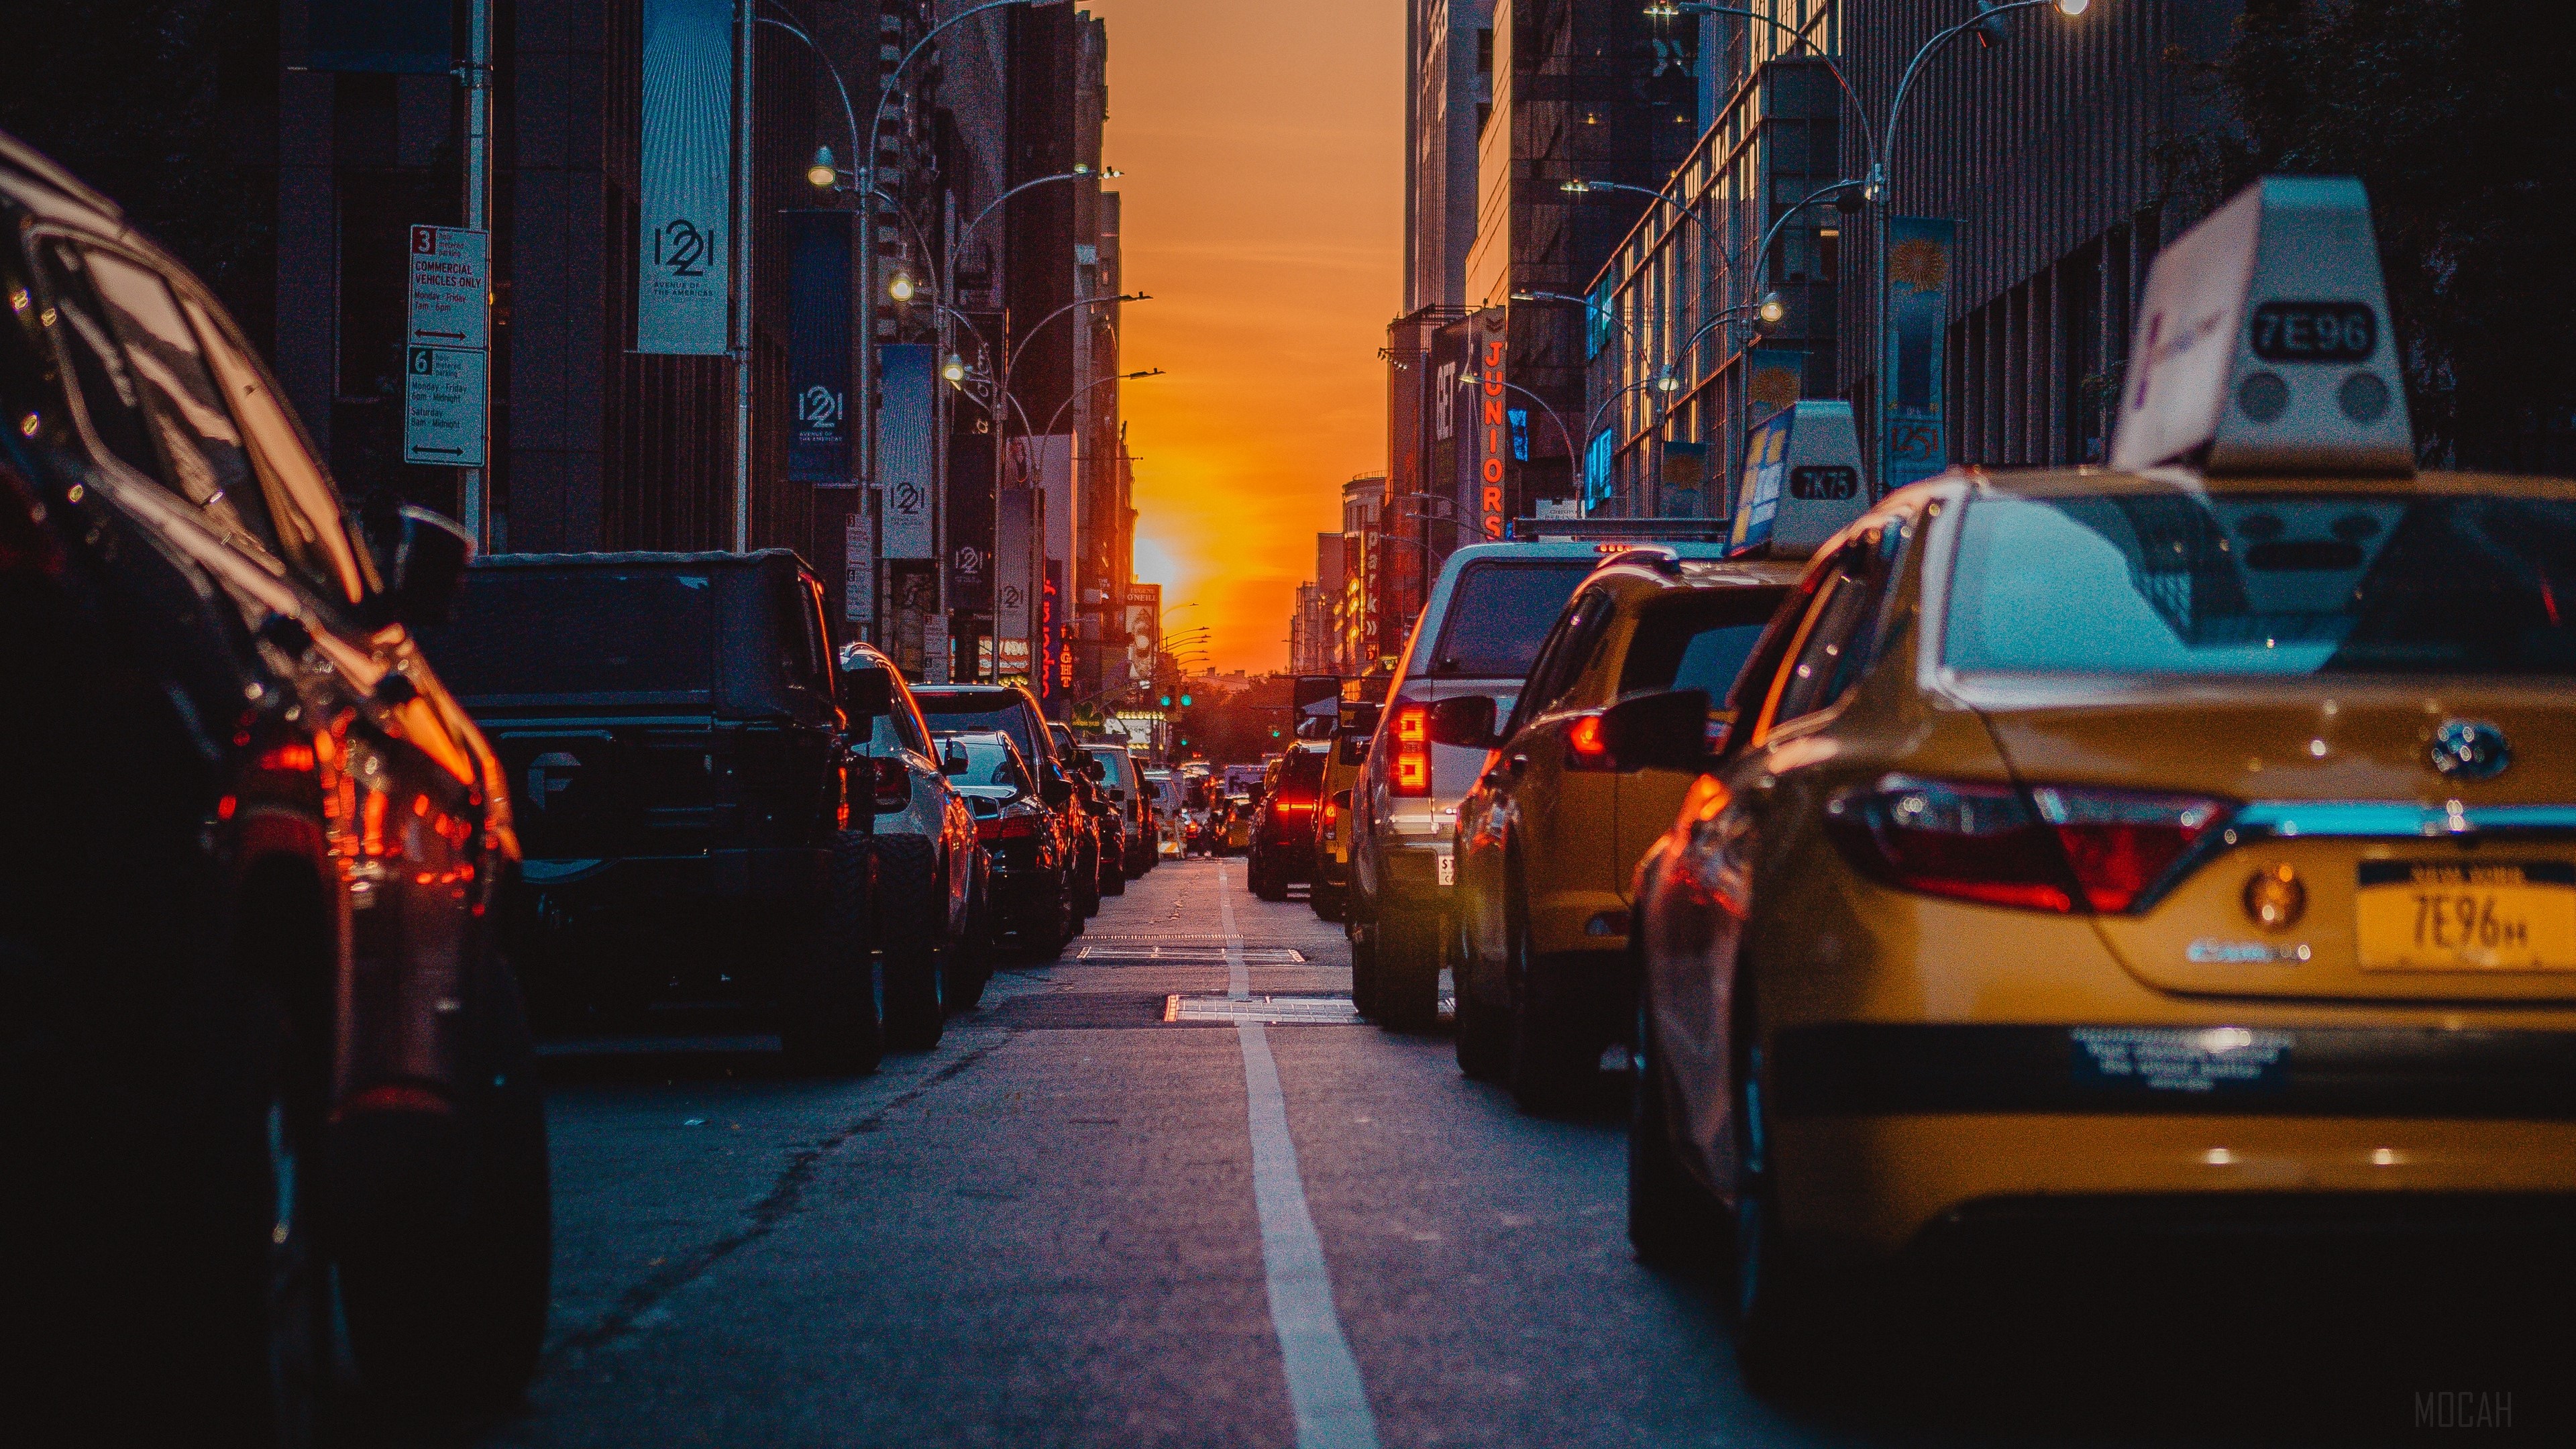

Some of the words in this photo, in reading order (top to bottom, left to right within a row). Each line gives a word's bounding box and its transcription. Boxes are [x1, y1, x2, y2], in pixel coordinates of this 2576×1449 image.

[418, 229, 430, 252] 3
[415, 260, 472, 276] COMMERCIAL
[415, 273, 457, 287] VEHICLES
[459, 276, 482, 288] ONLY
[415, 290, 440, 301] Monday
[445, 292, 467, 303] Friday
[415, 301, 429, 310] 7am
[435, 303, 451, 312] 6pm
[2258, 311, 2370, 352] 7E96
[415, 351, 427, 373] 6
[411, 380, 439, 392] Monday
[445, 382, 468, 394] Friday
[411, 394, 427, 402] 6pm
[433, 393, 460, 404] Midnight
[411, 407, 443, 417] Saturday
[432, 418, 460, 429] Midnight
[1891, 426, 1939, 462] 1251
[1802, 471, 1849, 499] 7K75
[1366, 531, 1379, 613] park
[1127, 594, 1157, 602] O'NEILL
